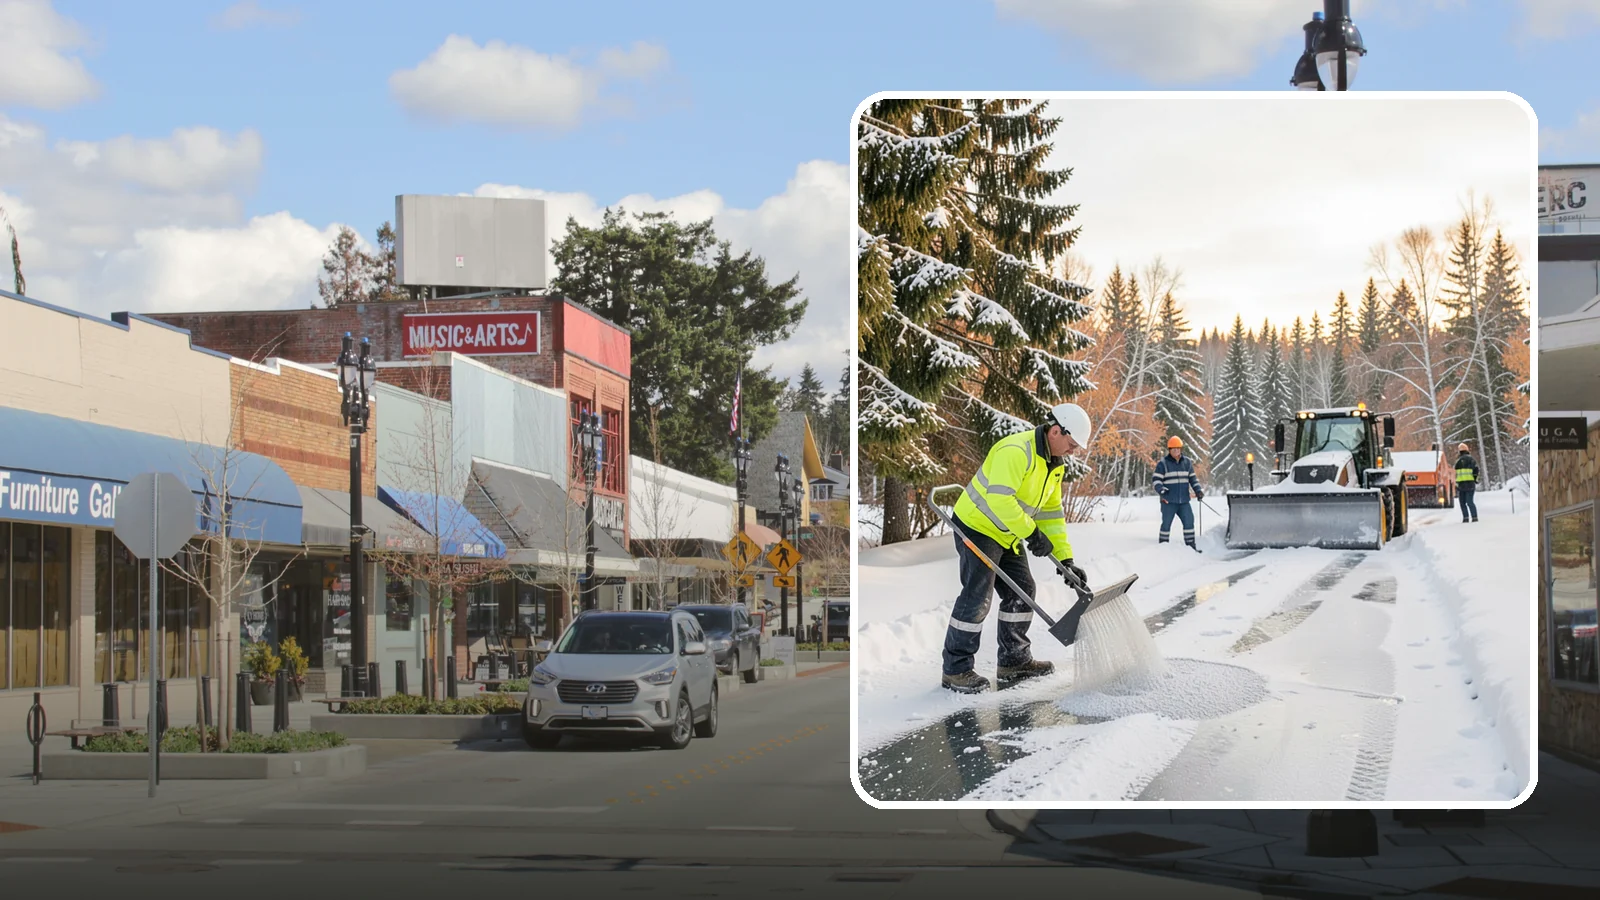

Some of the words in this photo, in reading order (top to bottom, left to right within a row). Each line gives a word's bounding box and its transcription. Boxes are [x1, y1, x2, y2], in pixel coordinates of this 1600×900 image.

[409, 323, 519, 348] MUSIC&ARTS
[1540, 428, 1577, 436] UGA
[0, 472, 79, 515] Furniture
[89, 482, 121, 519] Gal
